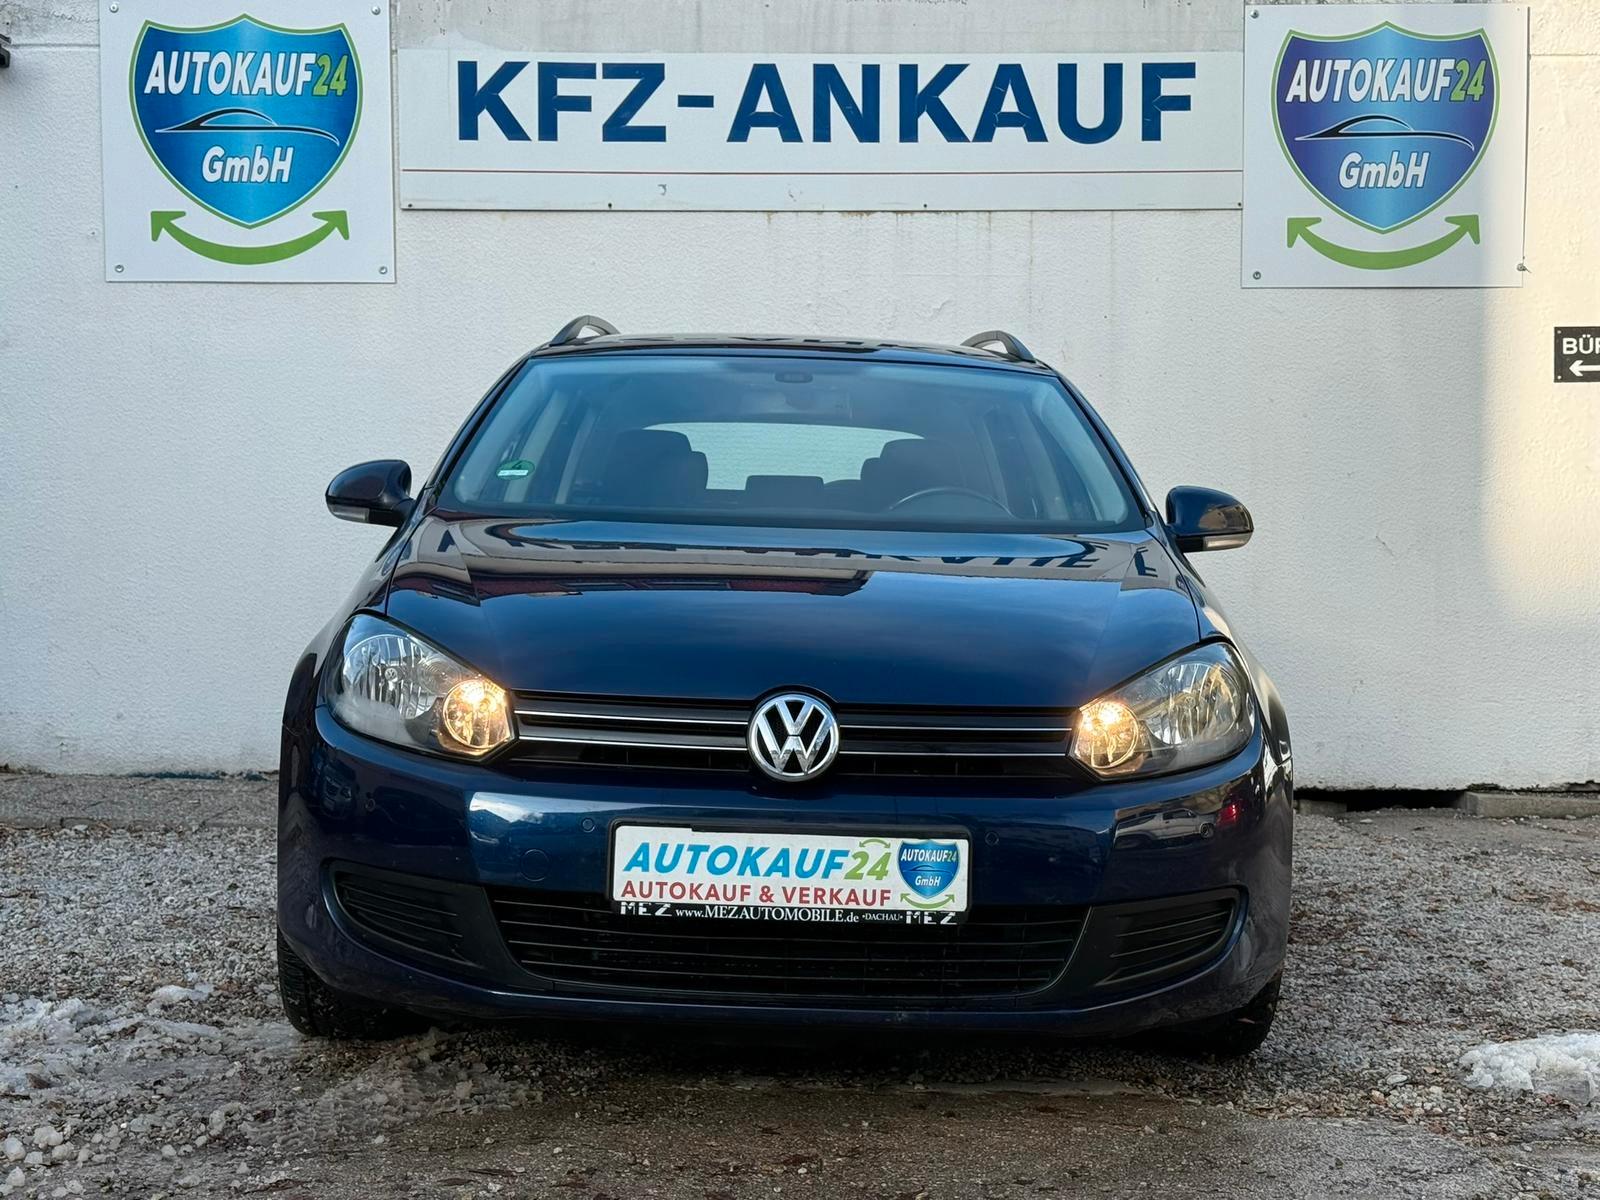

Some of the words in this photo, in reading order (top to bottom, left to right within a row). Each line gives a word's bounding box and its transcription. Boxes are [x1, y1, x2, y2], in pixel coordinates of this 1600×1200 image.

[143, 51, 348, 96] AUTOKAUF24
[1285, 58, 1487, 103] AUTOKAUF24
[457, 60, 1196, 144] KFZ-ANKAUF
[202, 145, 294, 183] GmbH
[1338, 151, 1430, 189] GmbH
[755, 697, 834, 775] VW
[623, 842, 892, 881] AUTOKAUF24
[900, 848, 957, 863] AUTOKAUF24
[621, 880, 751, 902] AUTOKAUF
[758, 885, 775, 903] &
[782, 886, 891, 906] VERKAUF
[914, 875, 941, 887] GmbH
[620, 902, 672, 916] MEZ
[675, 905, 859, 923] www.MEZAUTOMOBILE.de
[905, 911, 957, 925] MEZ
